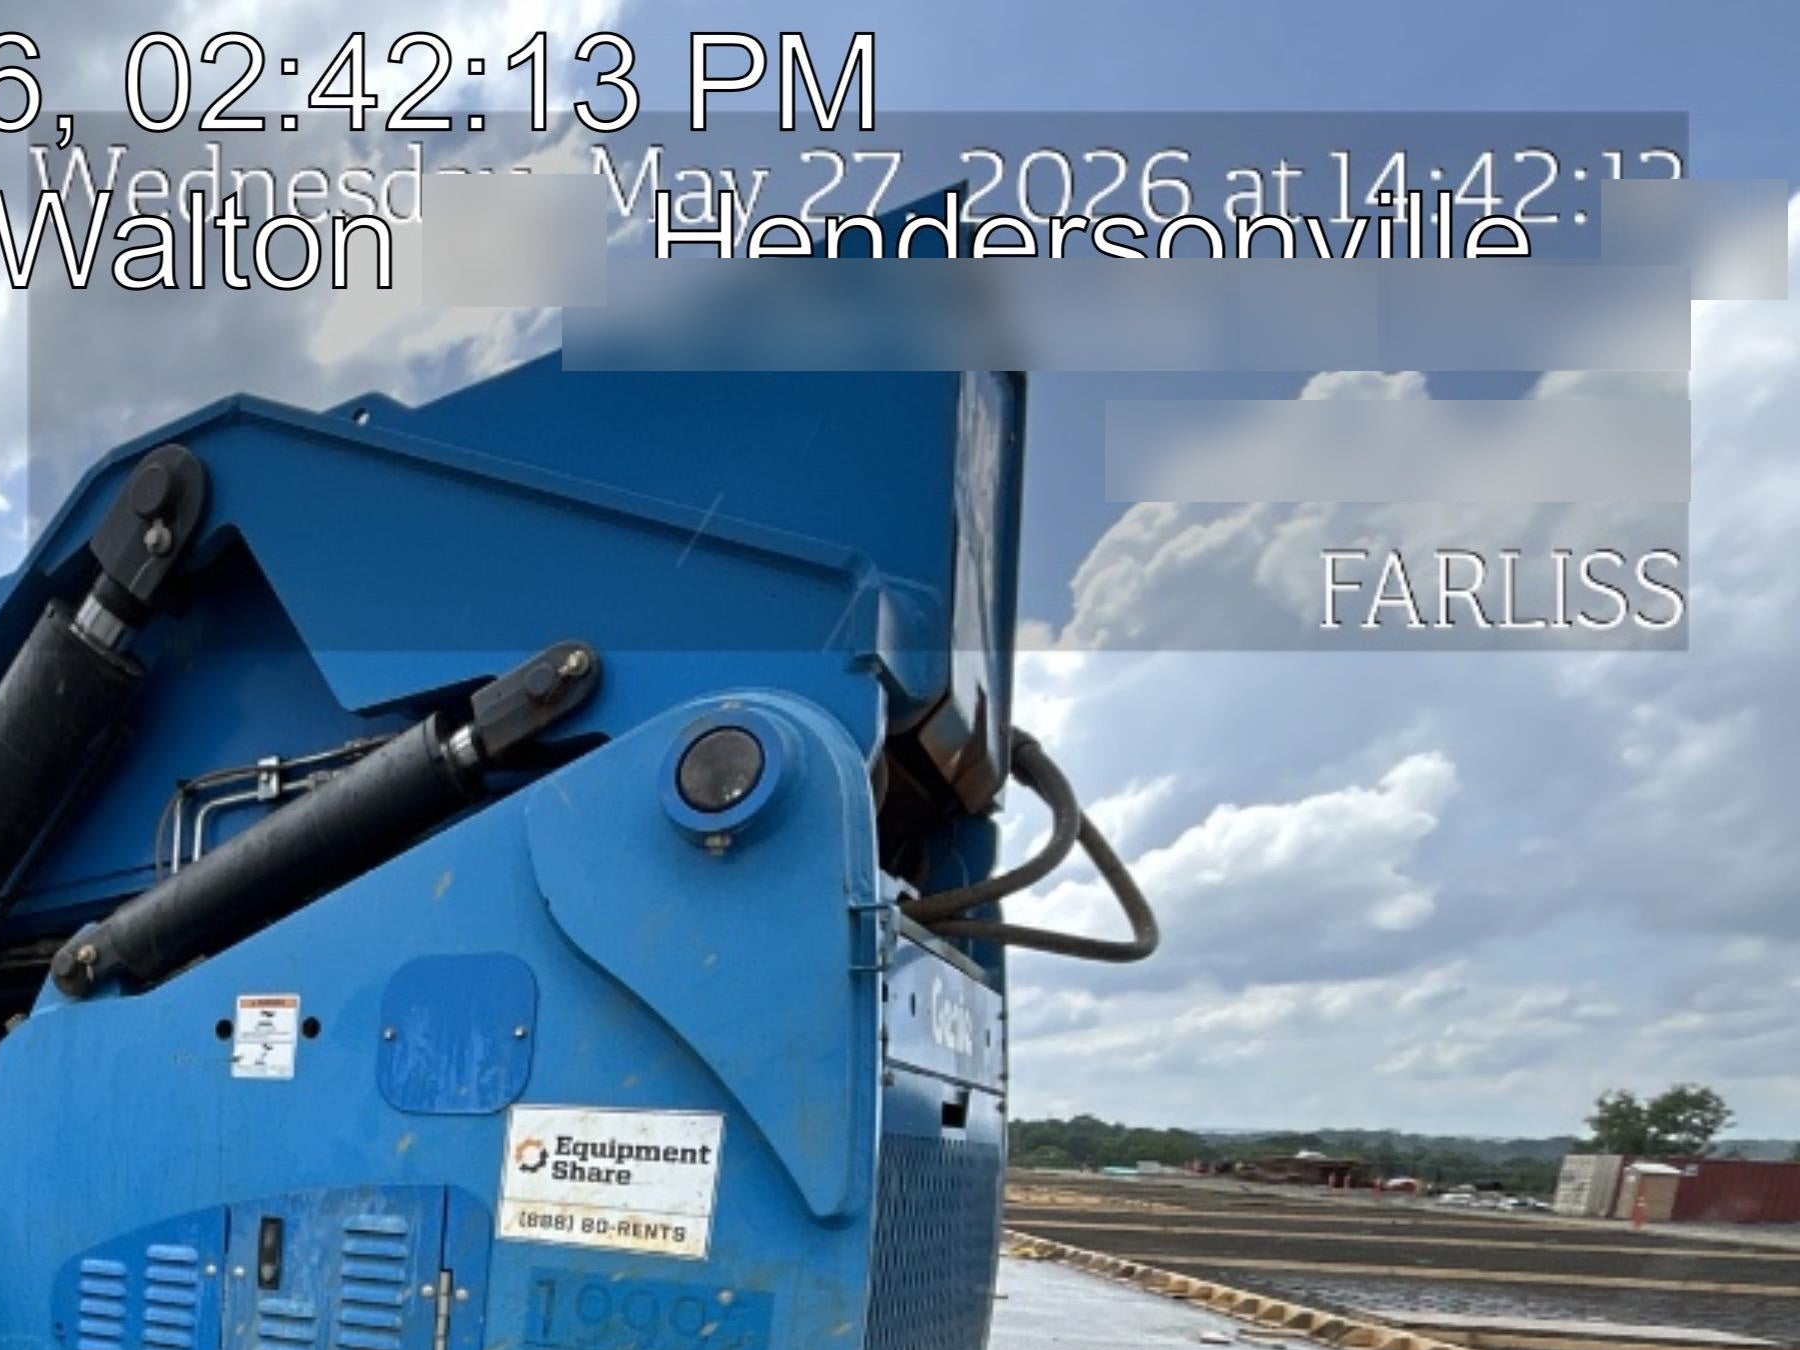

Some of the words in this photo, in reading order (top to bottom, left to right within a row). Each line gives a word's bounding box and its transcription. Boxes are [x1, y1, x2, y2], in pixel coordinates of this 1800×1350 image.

[554, 1136, 712, 1166] Equipment
[551, 1160, 632, 1186] Share
[519, 1210, 574, 1233] (888)
[581, 1217, 687, 1243] 80-RENTS
